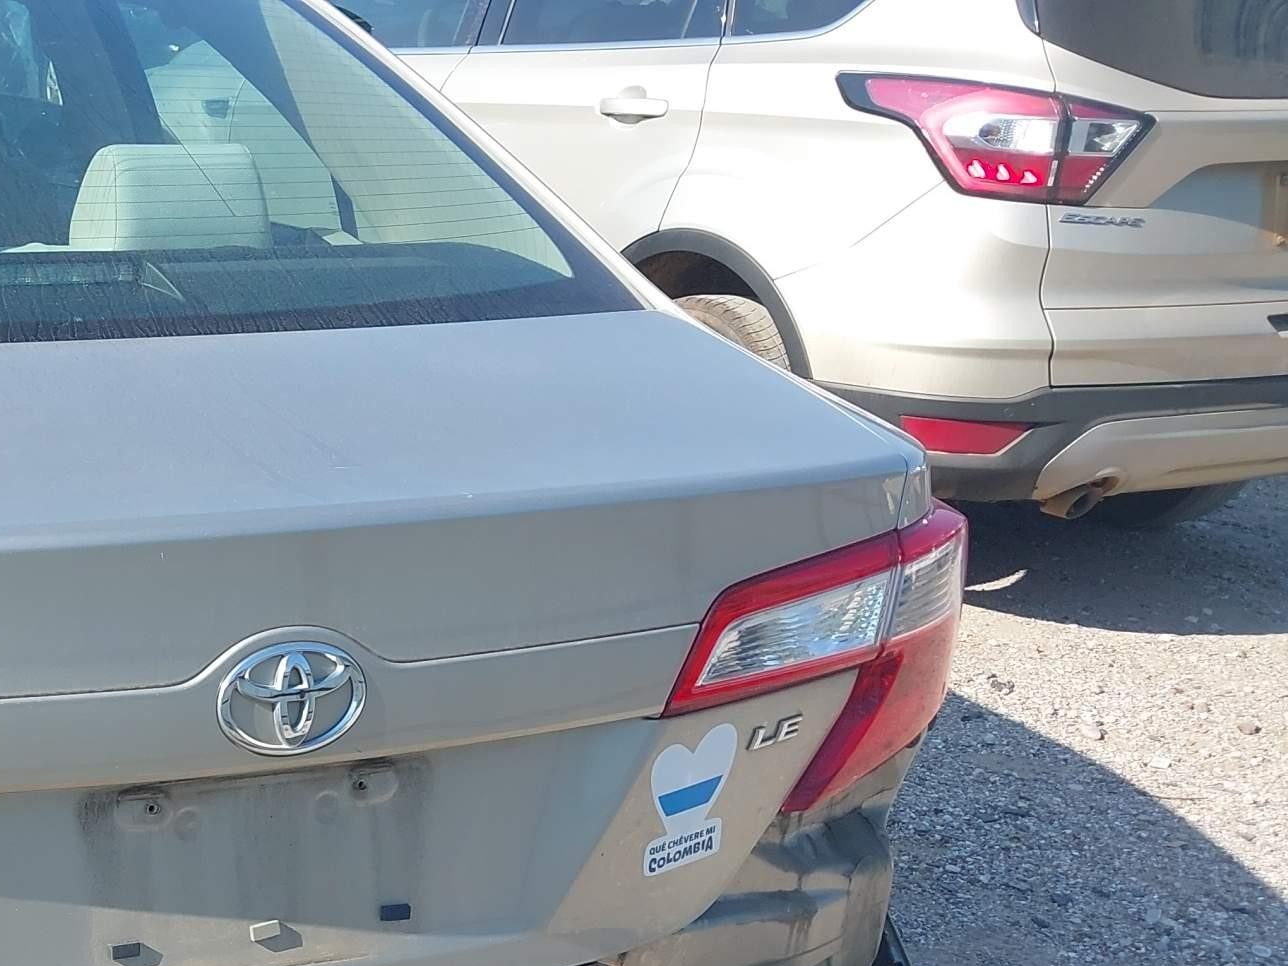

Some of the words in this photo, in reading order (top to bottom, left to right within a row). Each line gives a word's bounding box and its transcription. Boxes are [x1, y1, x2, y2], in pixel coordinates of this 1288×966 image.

[1058, 212, 1146, 228] ESCAPE
[746, 713, 803, 751] LE
[648, 836, 713, 873] COLOMBIA
[649, 841, 666, 855] QUÉ
[668, 830, 704, 849] CHÉVERE
[705, 825, 716, 835] MI
